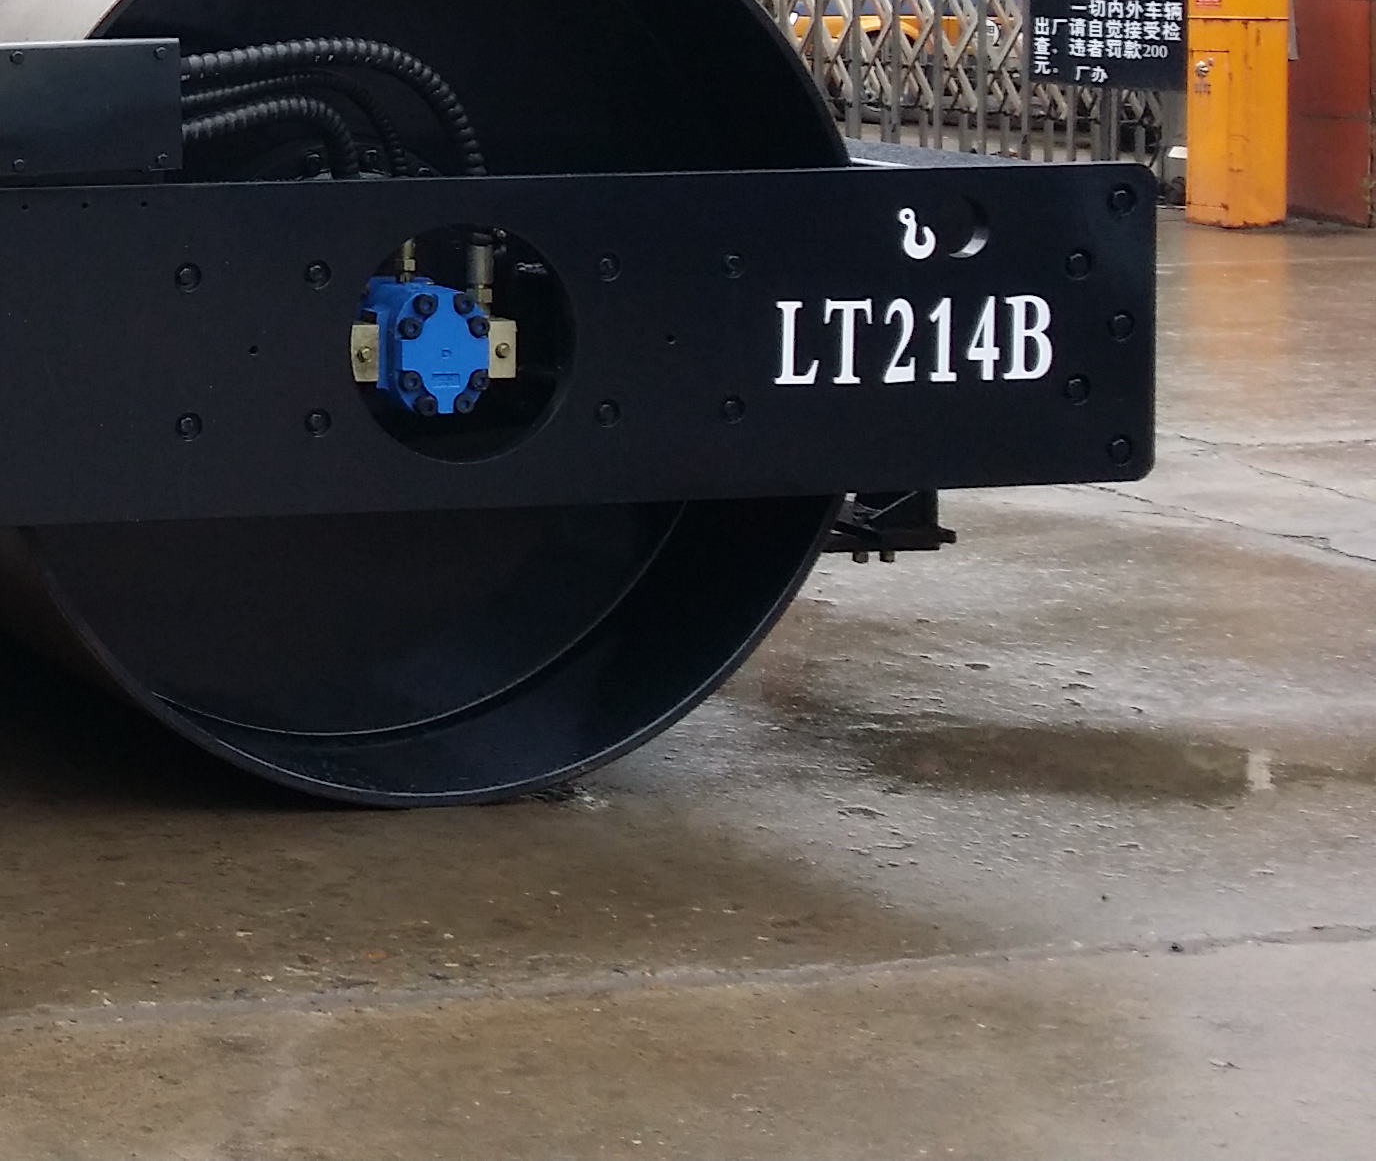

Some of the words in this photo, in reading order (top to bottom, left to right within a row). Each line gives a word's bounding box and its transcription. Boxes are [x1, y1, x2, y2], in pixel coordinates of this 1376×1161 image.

[1070, 0, 1183, 21] 一切内外车辆
[1033, 16, 1182, 41] 出厂请自觉接受检
[1074, 65, 1109, 84] 厂办
[773, 294, 1054, 385] LT214B
